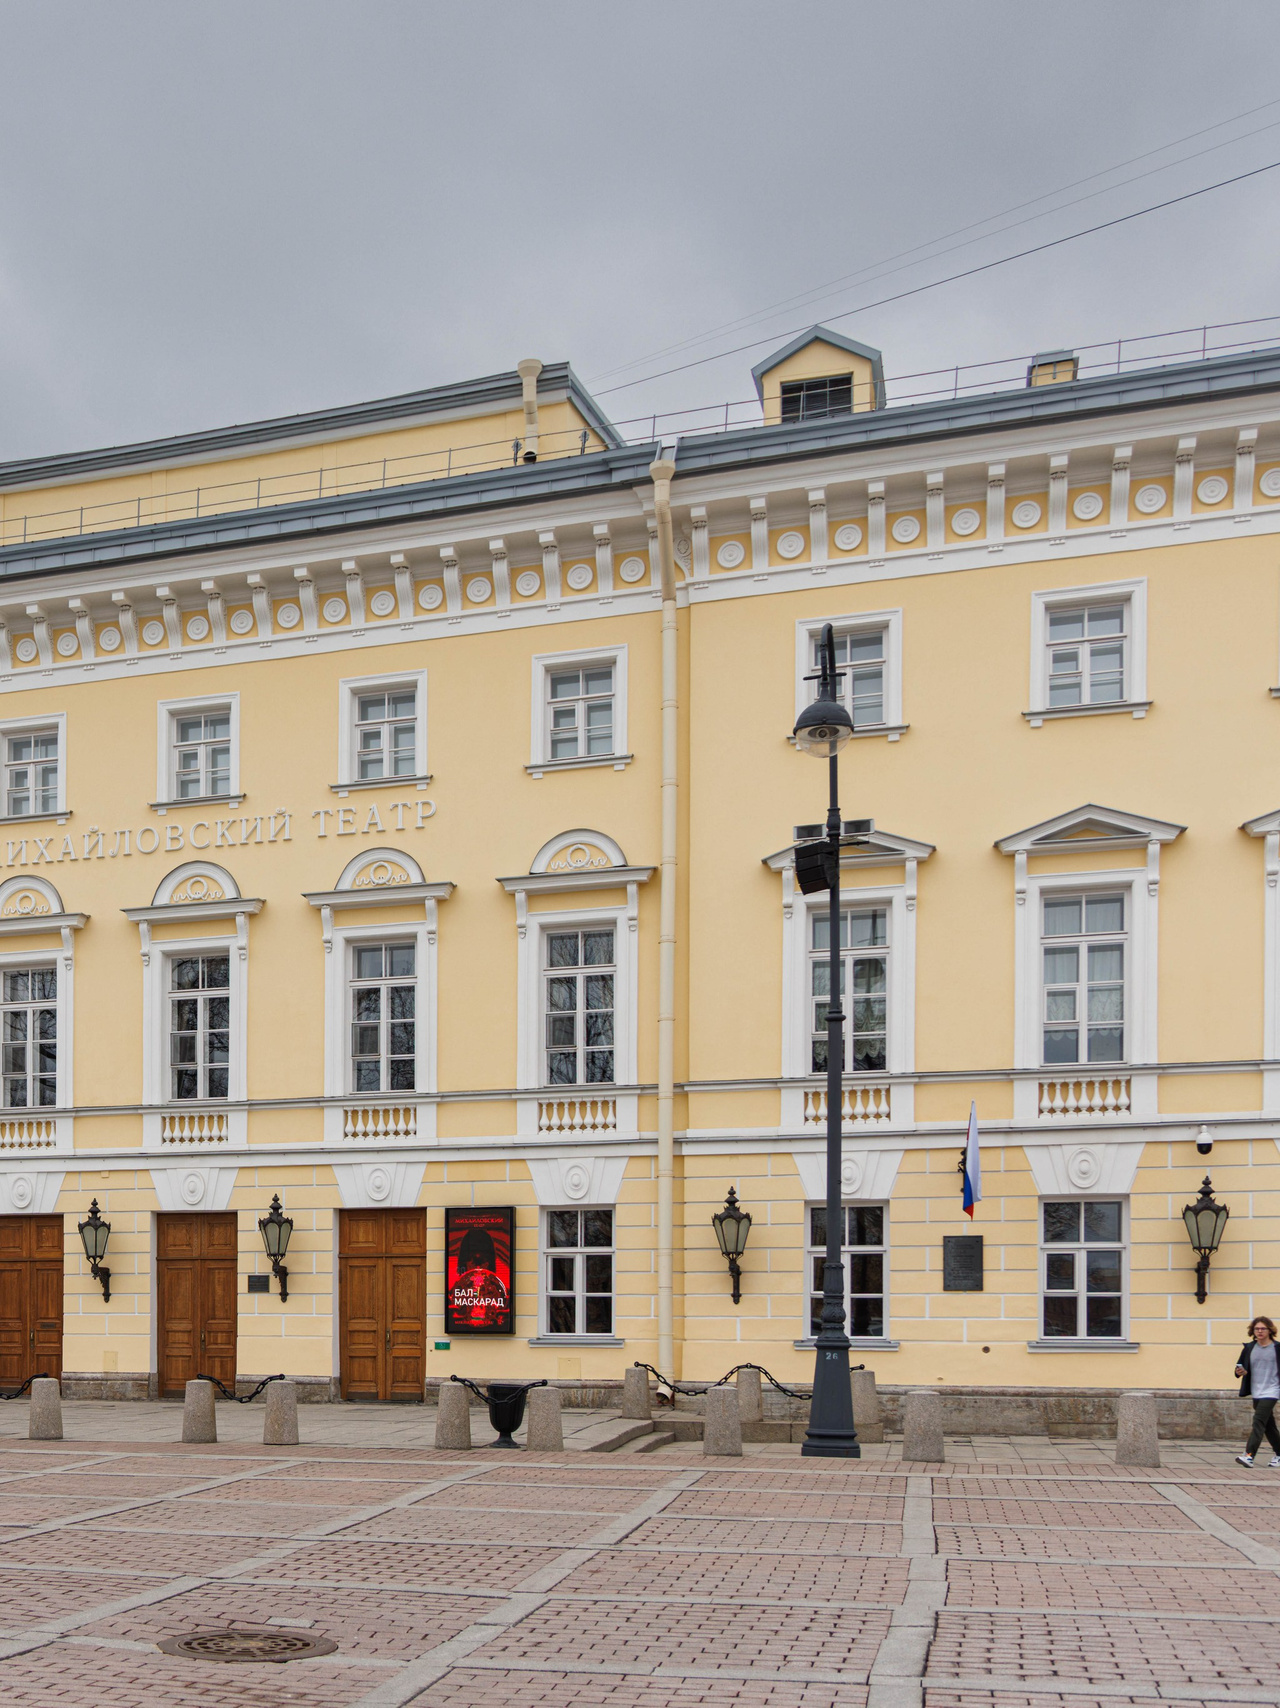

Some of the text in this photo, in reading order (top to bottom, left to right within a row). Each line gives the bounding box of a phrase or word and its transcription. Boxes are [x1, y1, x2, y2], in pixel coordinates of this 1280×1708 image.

[312, 800, 437, 838] ТЕАТР
[454, 1289, 478, 1297] БАЛ-
[454, 1298, 505, 1307] МАСКАРАД
[825, 1352, 838, 1360] 26
